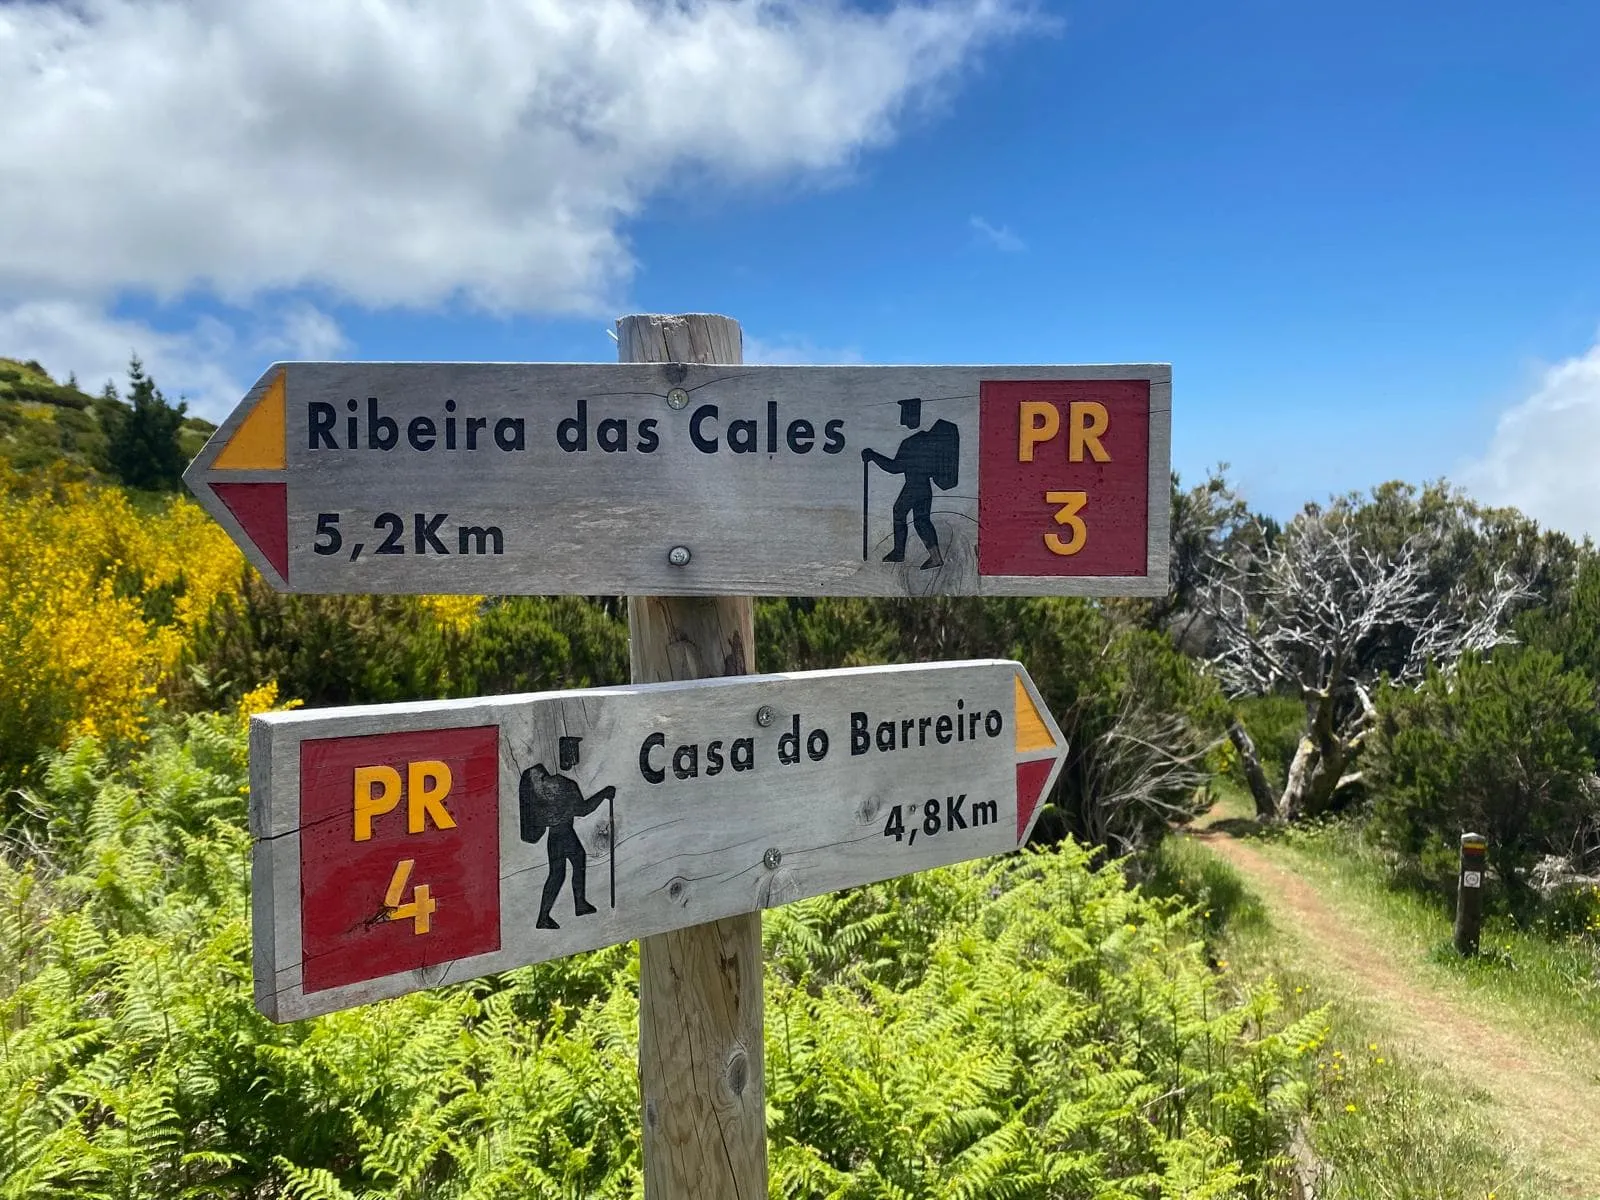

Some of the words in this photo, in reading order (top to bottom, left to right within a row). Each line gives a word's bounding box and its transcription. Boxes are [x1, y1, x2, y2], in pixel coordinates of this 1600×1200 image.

[308, 398, 526, 452] Ribeira
[556, 399, 660, 454] das
[689, 400, 846, 454] Cales
[1018, 401, 1112, 463] PR
[313, 512, 505, 562] 5,2Km
[1044, 491, 1088, 556] 3
[639, 731, 755, 784] Casa
[777, 713, 830, 766] do
[850, 699, 1003, 756] Barreiro
[353, 760, 457, 842] PR
[883, 794, 999, 846] 4,8Km
[384, 858, 437, 935] 4
